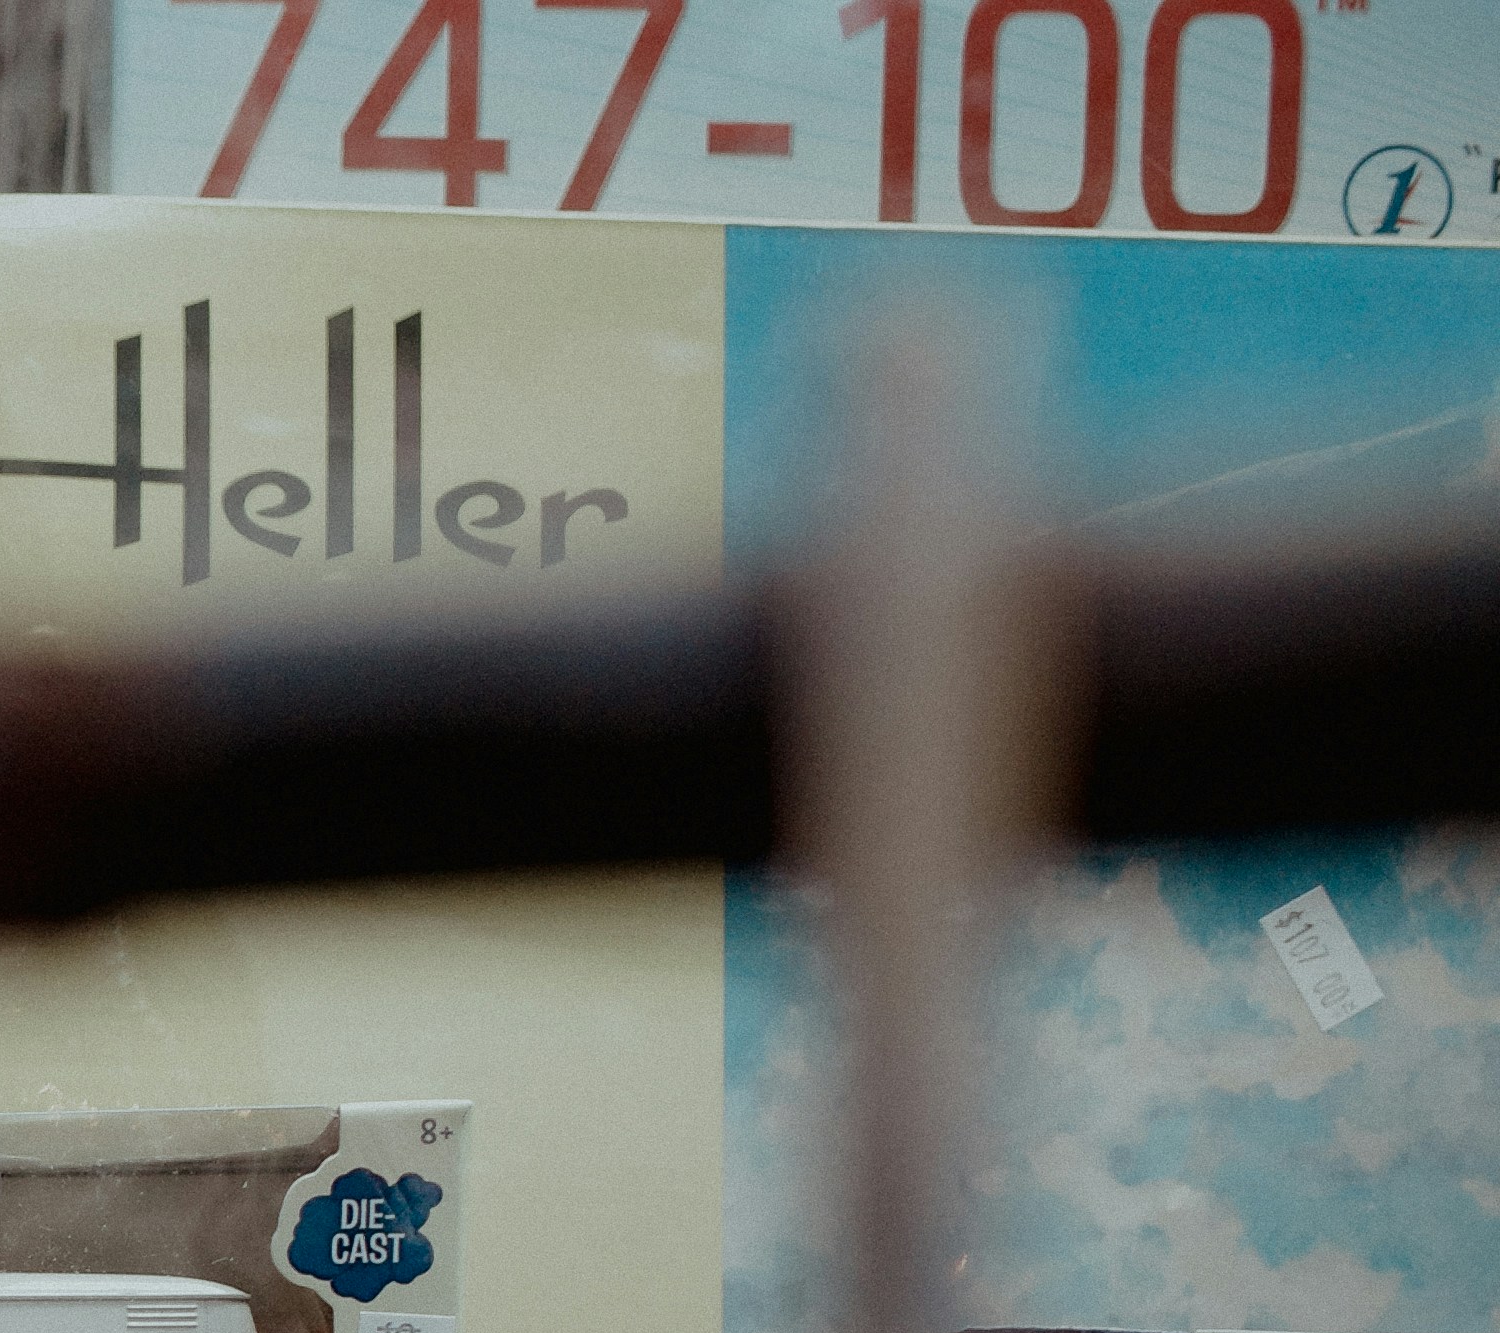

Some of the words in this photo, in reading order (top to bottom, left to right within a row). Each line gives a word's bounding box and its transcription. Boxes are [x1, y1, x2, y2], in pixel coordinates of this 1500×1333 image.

[421, 1118, 454, 1145] 8+
[341, 1200, 396, 1230] DIE-
[331, 1234, 404, 1264] CAST
